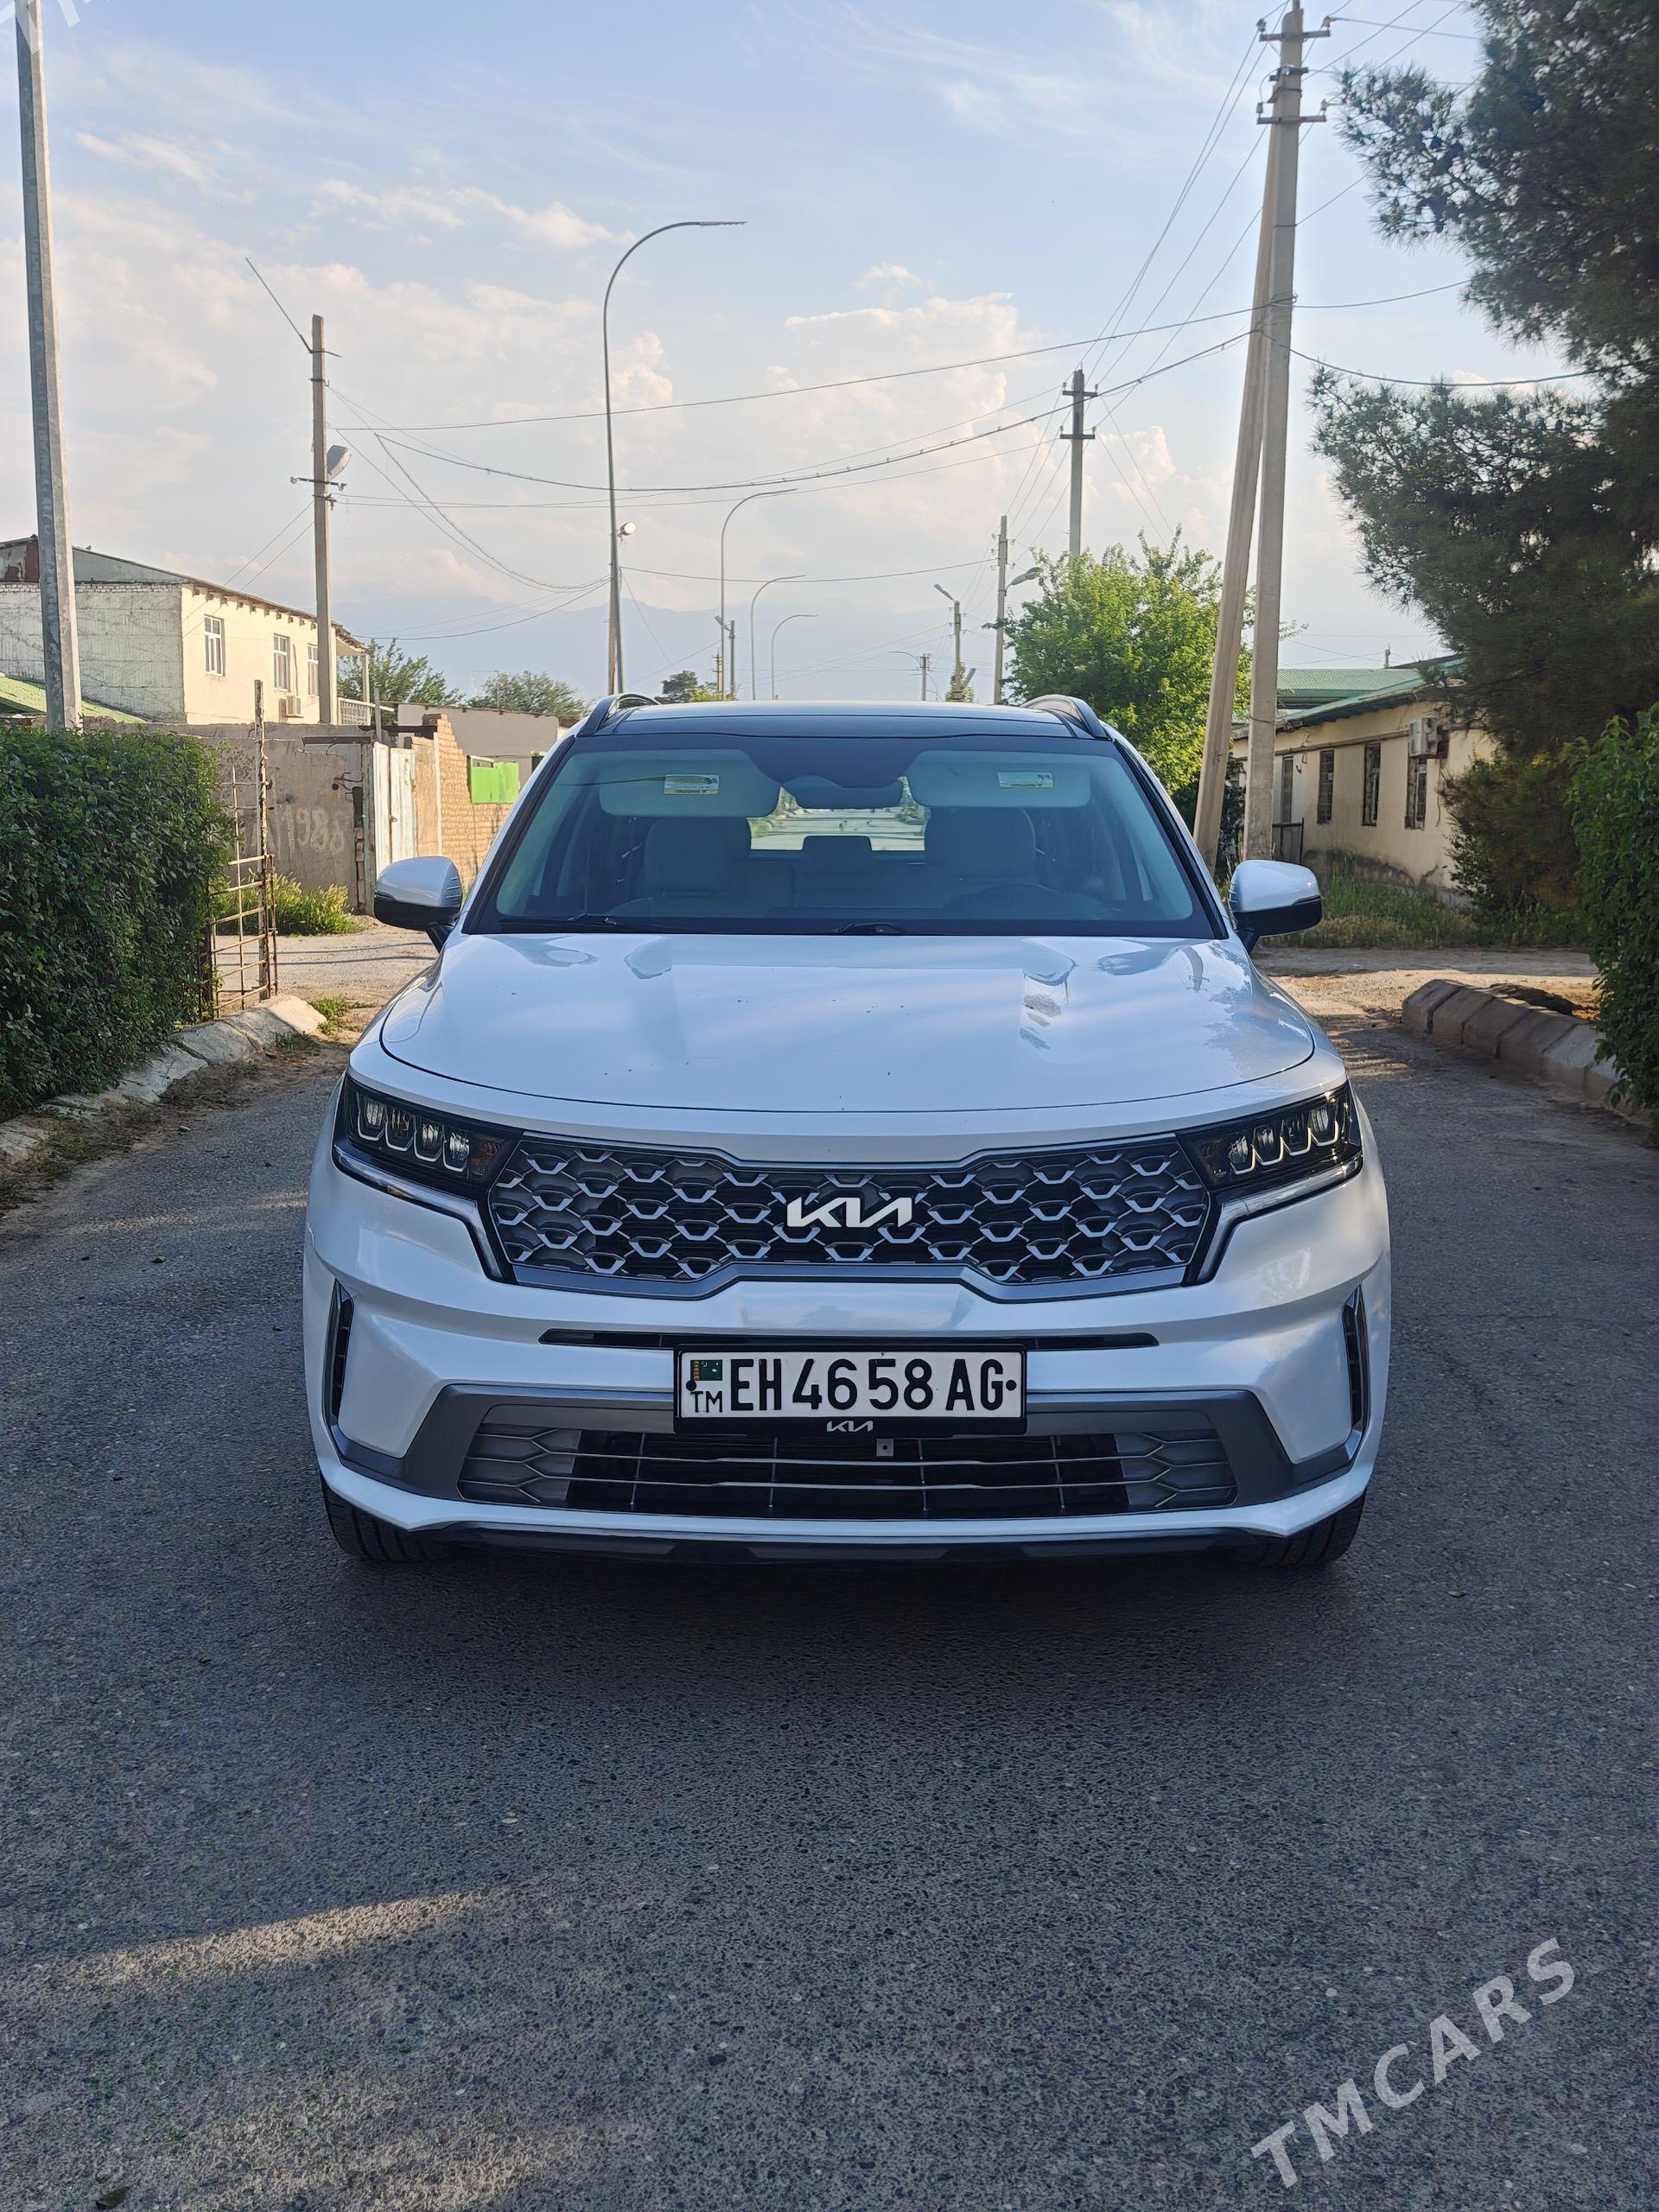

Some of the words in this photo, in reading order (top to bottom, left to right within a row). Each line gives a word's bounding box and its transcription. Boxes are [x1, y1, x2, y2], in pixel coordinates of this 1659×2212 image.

[786, 1197, 912, 1228] KIA
[692, 1390, 723, 1413] TM
[826, 1420, 874, 1433] KIA
